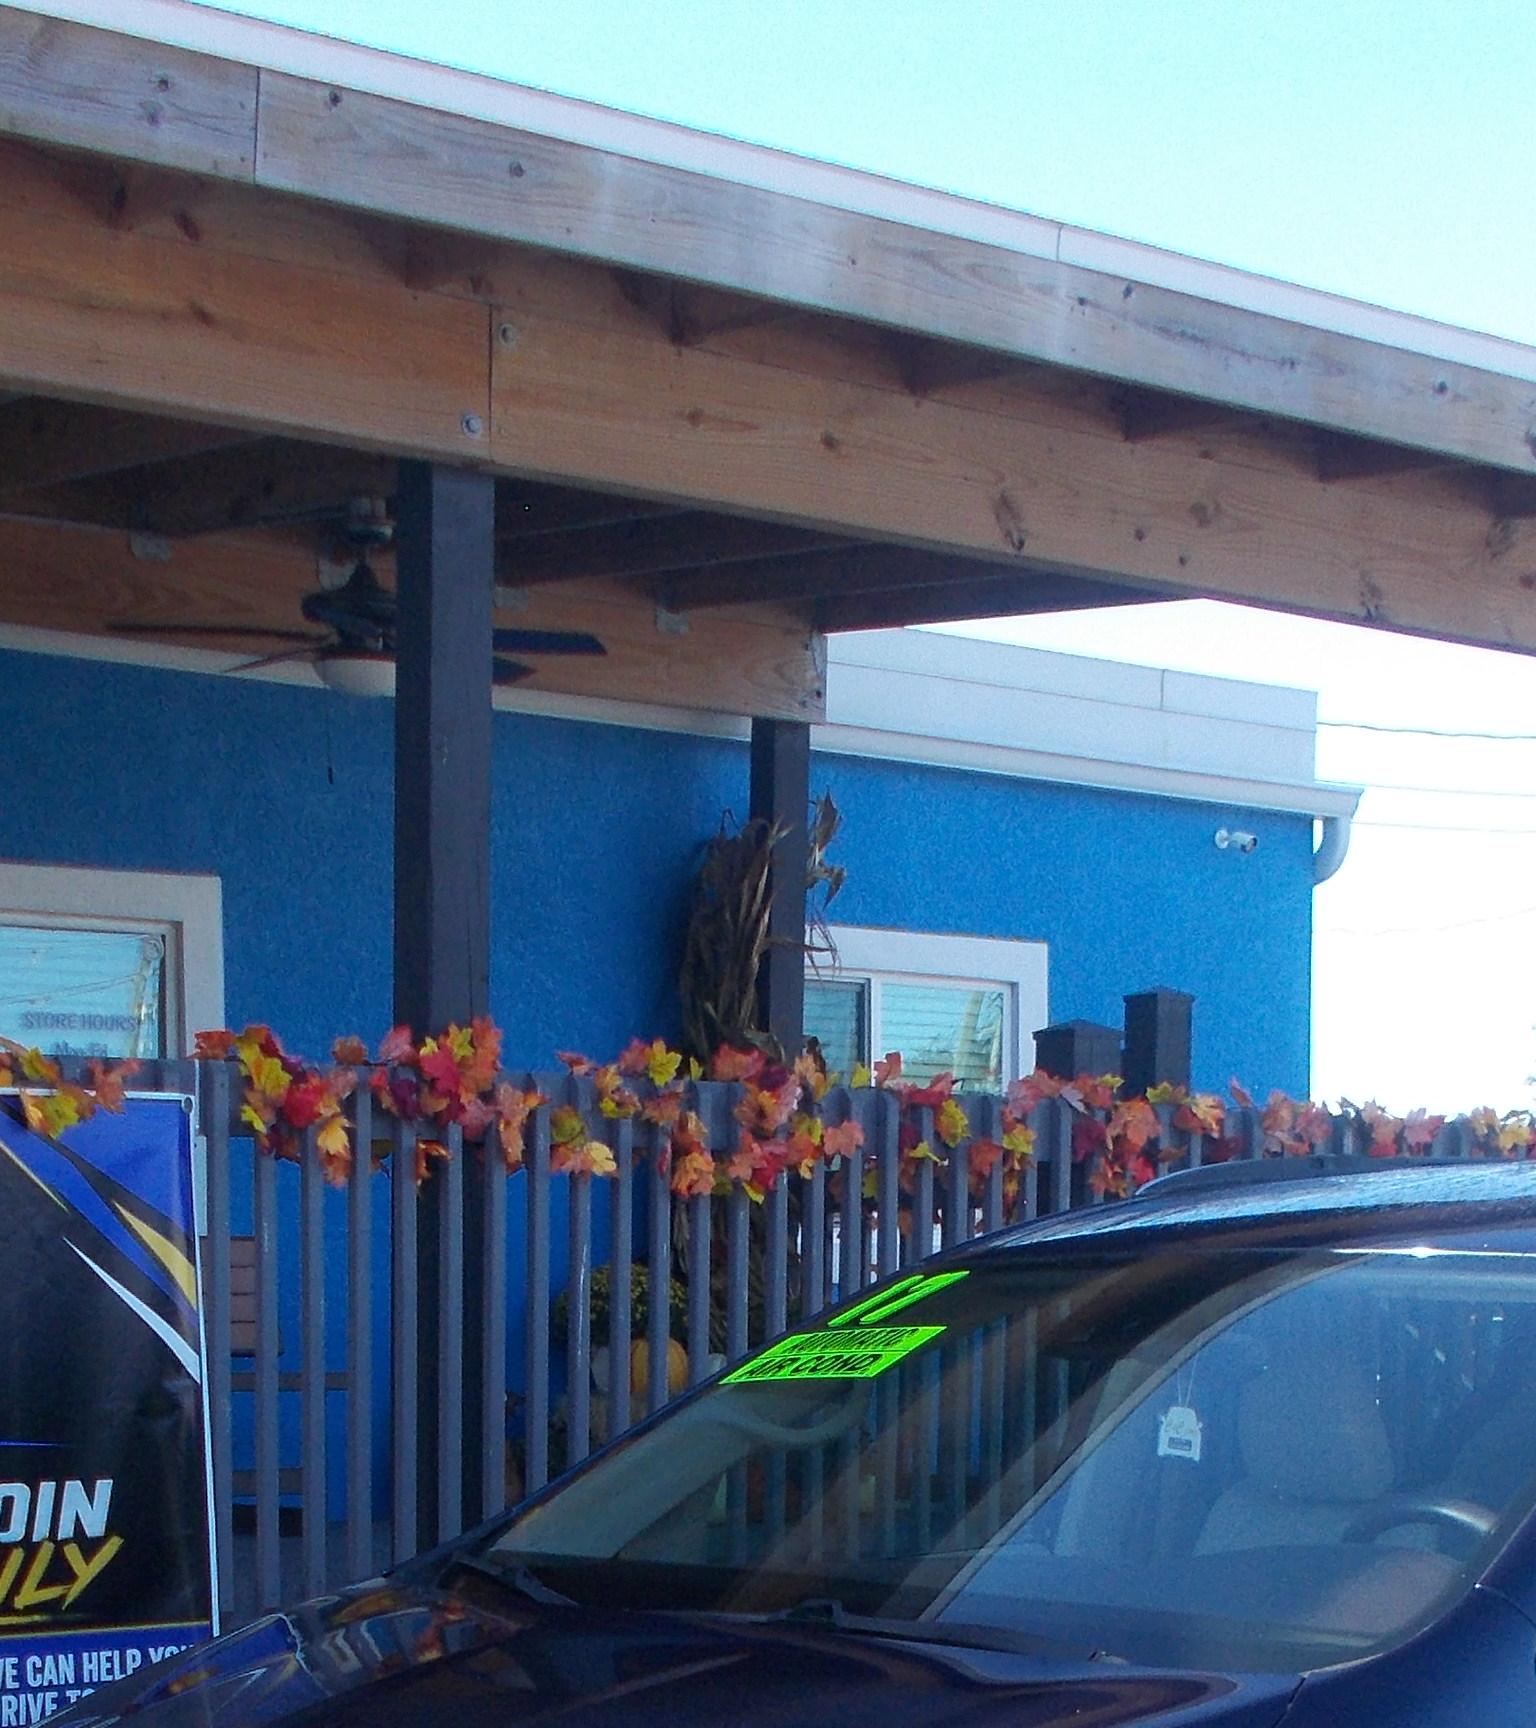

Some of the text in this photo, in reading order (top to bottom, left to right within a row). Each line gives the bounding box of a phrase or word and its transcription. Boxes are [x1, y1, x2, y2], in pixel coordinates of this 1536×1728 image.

[22, 1012, 137, 1032] STORE HOURS
[26, 1653, 75, 1688] CAN
[82, 1648, 142, 1683] HELP
